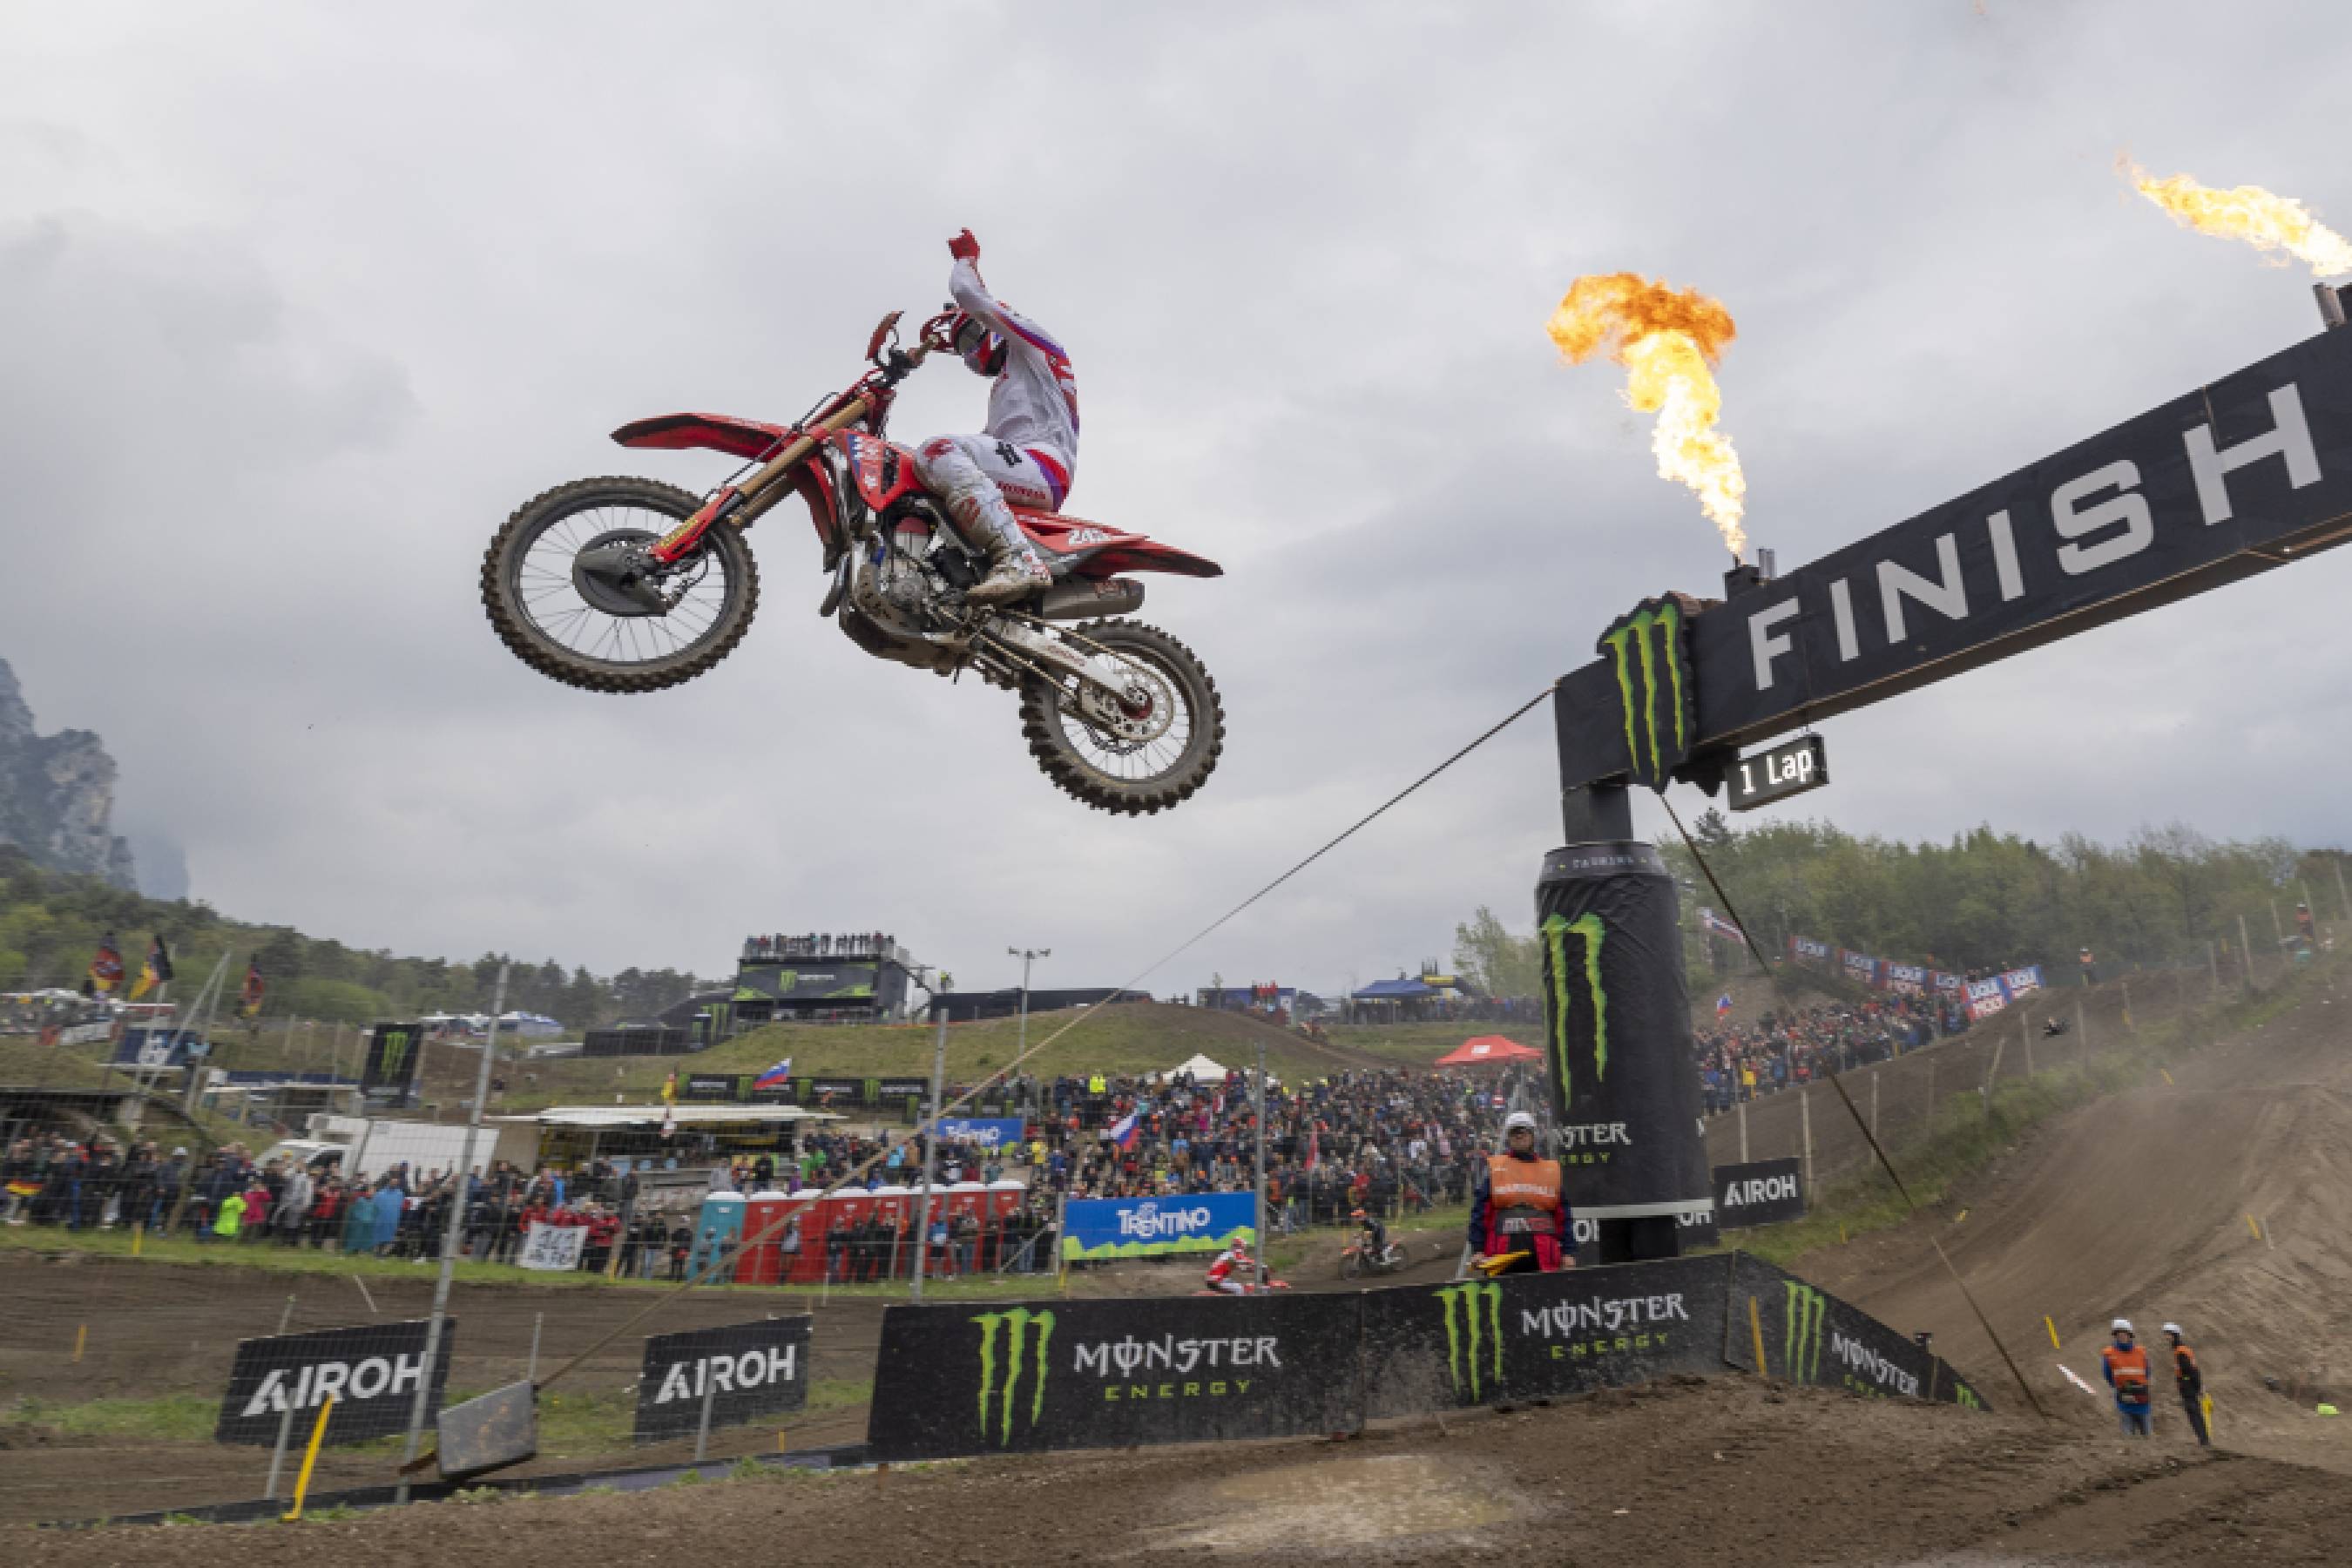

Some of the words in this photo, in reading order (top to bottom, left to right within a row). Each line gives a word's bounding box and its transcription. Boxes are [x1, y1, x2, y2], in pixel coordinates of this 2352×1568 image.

[1747, 382, 2322, 691] FINISH
[1740, 763, 1756, 794] 1
[1766, 749, 1812, 785] Lap
[1724, 1173, 1797, 1206] AIROH
[1519, 1293, 1691, 1339] MONSTER
[1073, 1333, 1282, 1378] MONSTER
[1549, 1332, 1668, 1360] ENERGY
[1831, 1332, 1919, 1397] MONSTER
[240, 1350, 428, 1417] AIROH
[655, 1343, 795, 1404] AIROH
[1104, 1379, 1252, 1402] ENERGY
